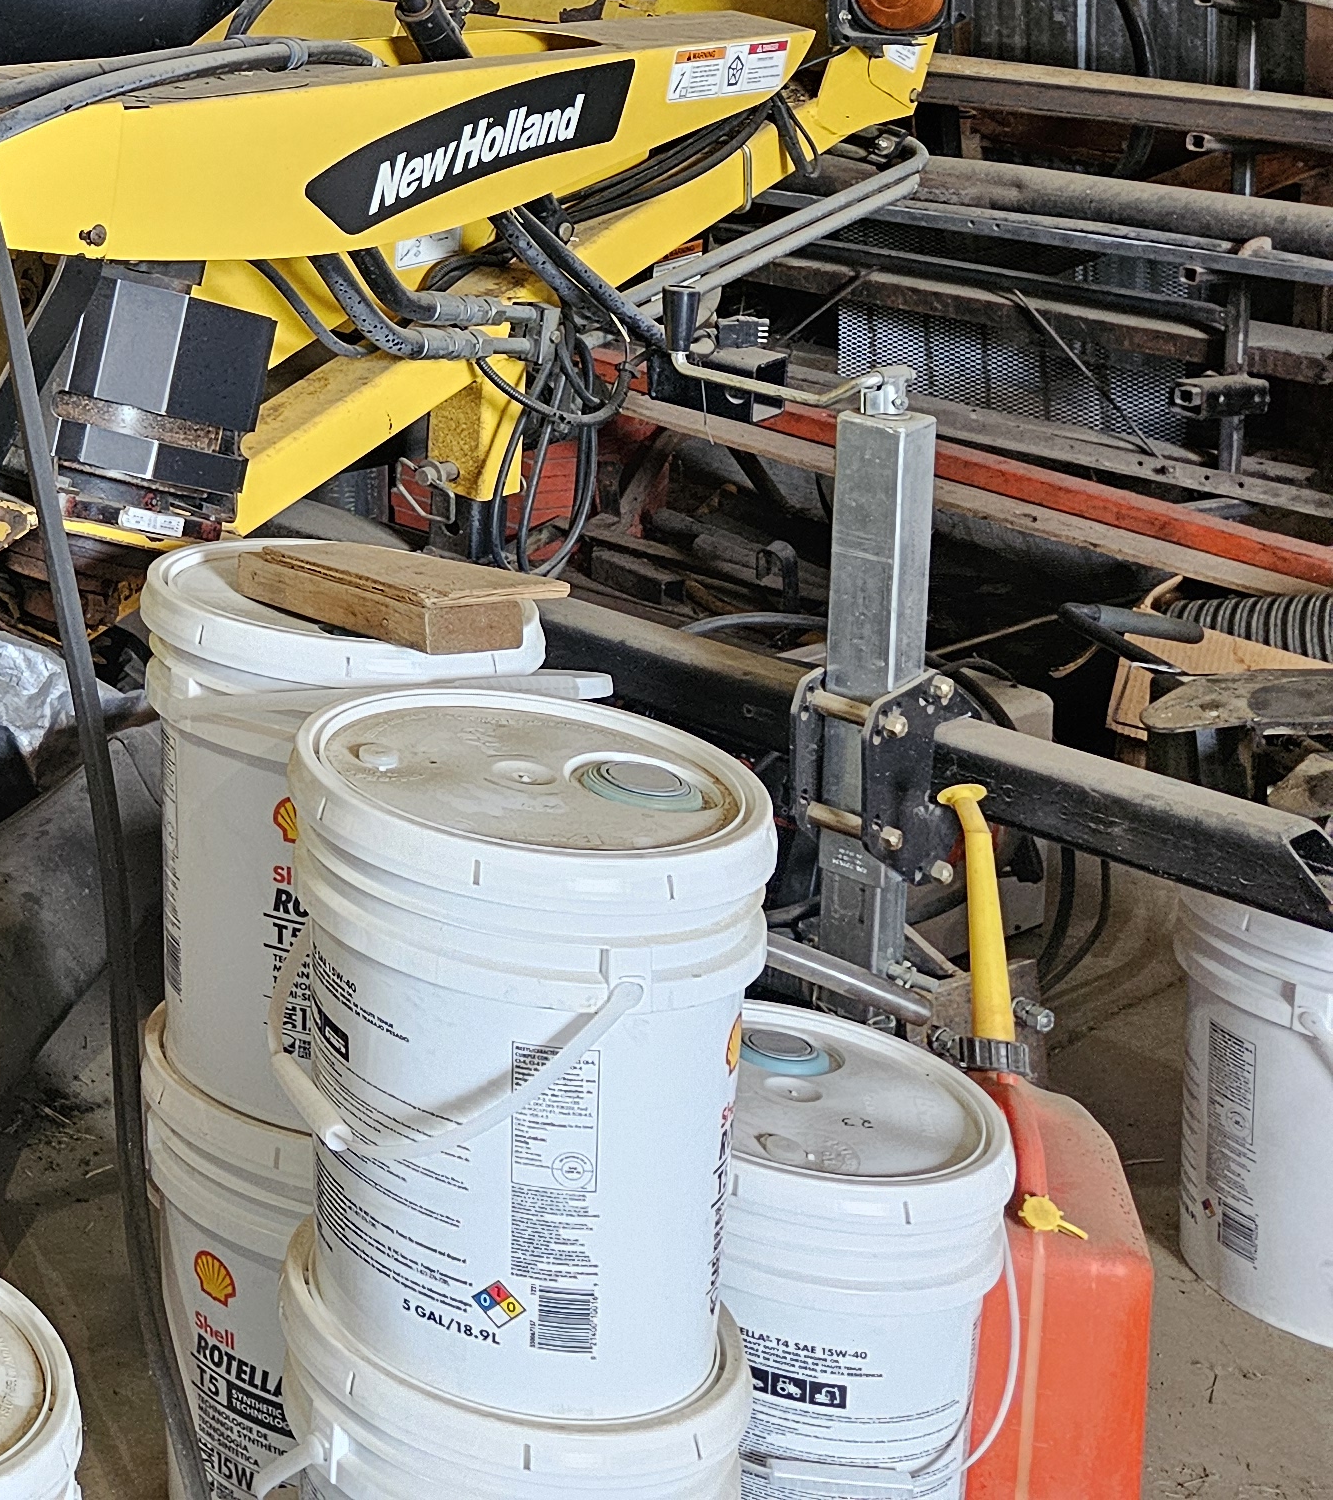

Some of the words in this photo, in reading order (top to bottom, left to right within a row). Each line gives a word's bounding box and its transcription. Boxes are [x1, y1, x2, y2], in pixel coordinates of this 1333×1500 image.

[692, 50, 716, 60] WARNING
[368, 141, 458, 216] New
[452, 93, 586, 176] Holland
[480, 1293, 490, 1307] 0
[506, 1301, 516, 1313] 0
[194, 1310, 236, 1350] Shell
[402, 1298, 412, 1312] 5
[415, 1304, 502, 1346] GAL/18.9L
[196, 1332, 283, 1398] ROTELLA
[775, 1337, 790, 1349] T4
[794, 1342, 817, 1354] SAE
[821, 1347, 868, 1360] 15W-40
[196, 1362, 220, 1398] T5
[198, 1392, 254, 1434] TECHNOLOGIE
[256, 1429, 269, 1441] DE
[231, 1389, 283, 1419] SYNTHETIC
[216, 1450, 255, 1492] 15W
